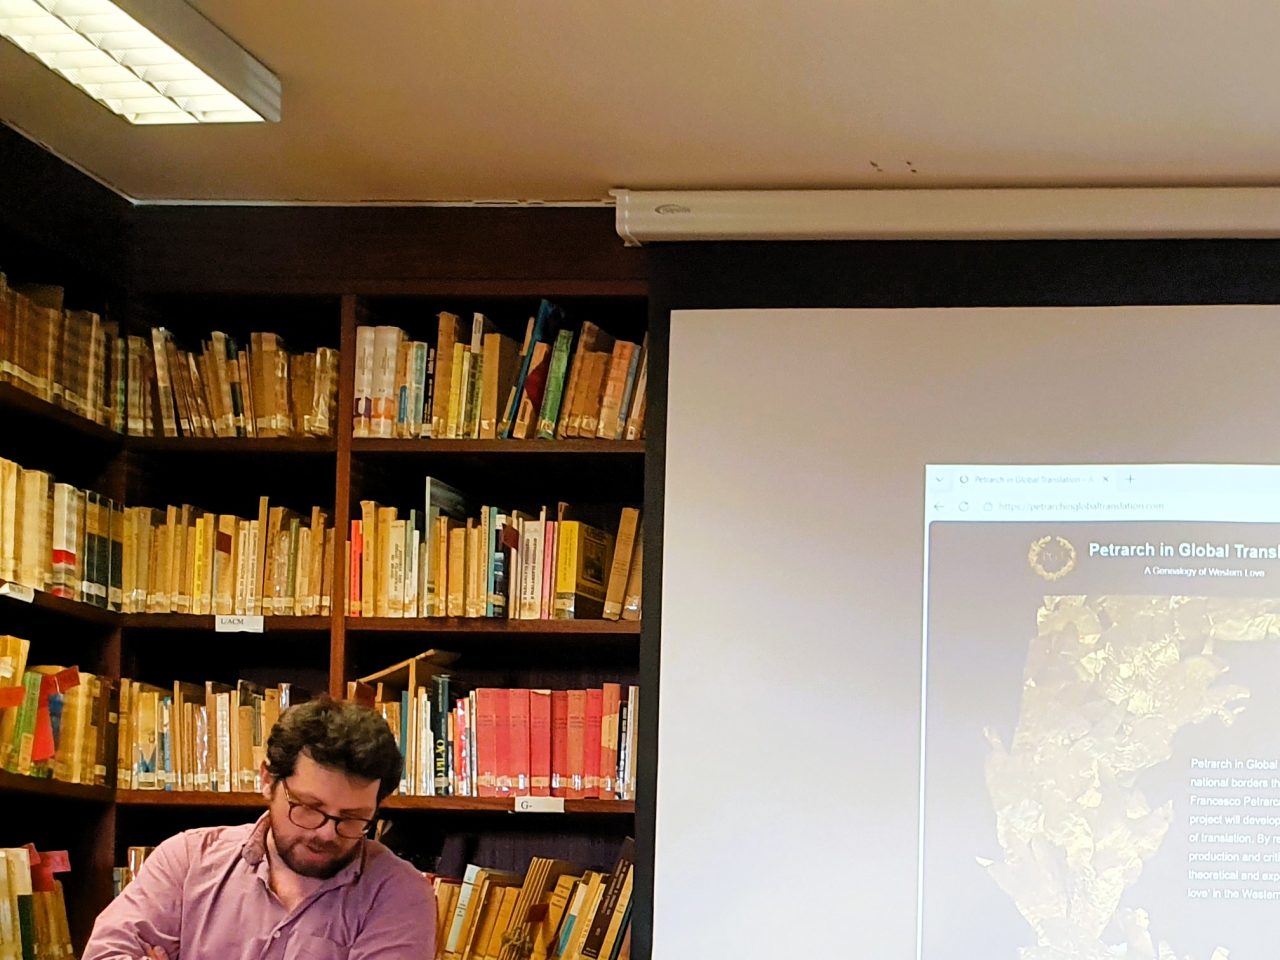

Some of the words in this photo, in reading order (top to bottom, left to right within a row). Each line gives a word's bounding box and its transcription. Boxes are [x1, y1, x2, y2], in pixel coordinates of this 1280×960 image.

[1090, 543, 1154, 556] Petrarch
[1161, 543, 1173, 556] in
[1179, 543, 1229, 557] Global
[1153, 567, 1196, 576] Genealogy
[1209, 568, 1242, 576] Western
